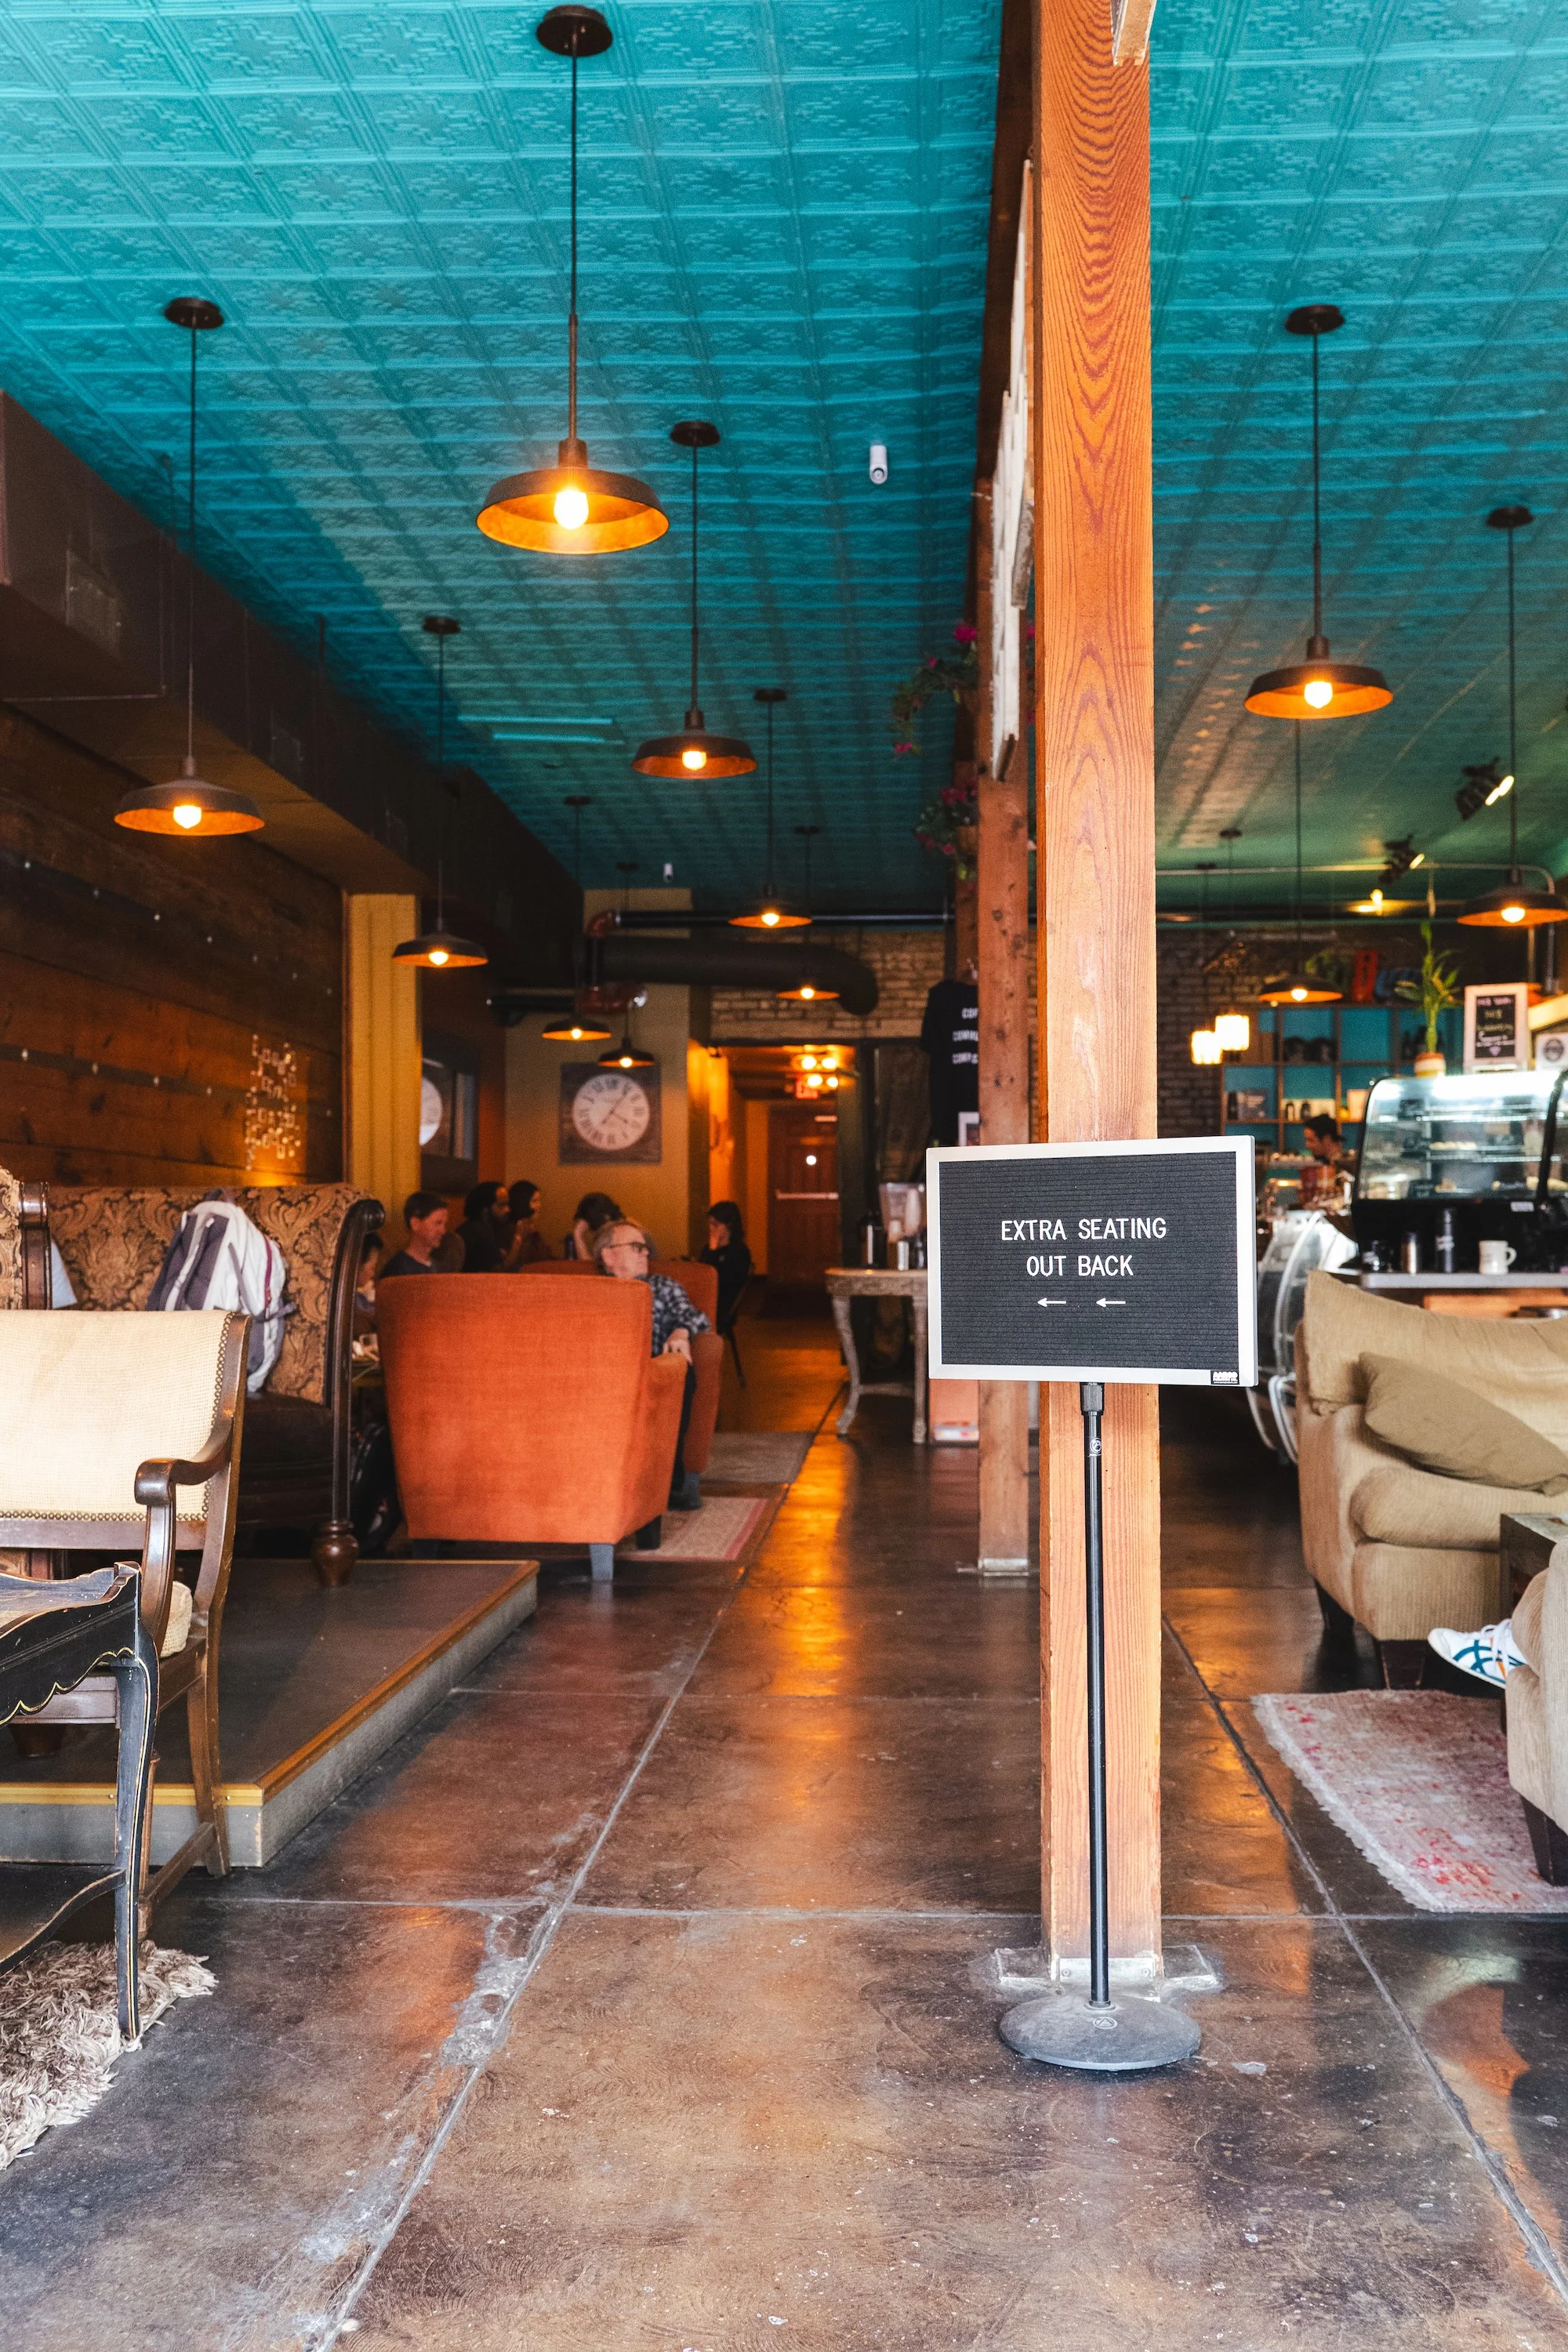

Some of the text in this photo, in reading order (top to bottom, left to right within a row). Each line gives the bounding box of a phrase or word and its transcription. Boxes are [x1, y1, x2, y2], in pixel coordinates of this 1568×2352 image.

[1001, 1217, 1167, 1241] EXTRA SEATING
[1026, 1254, 1134, 1277] OUT BACK
